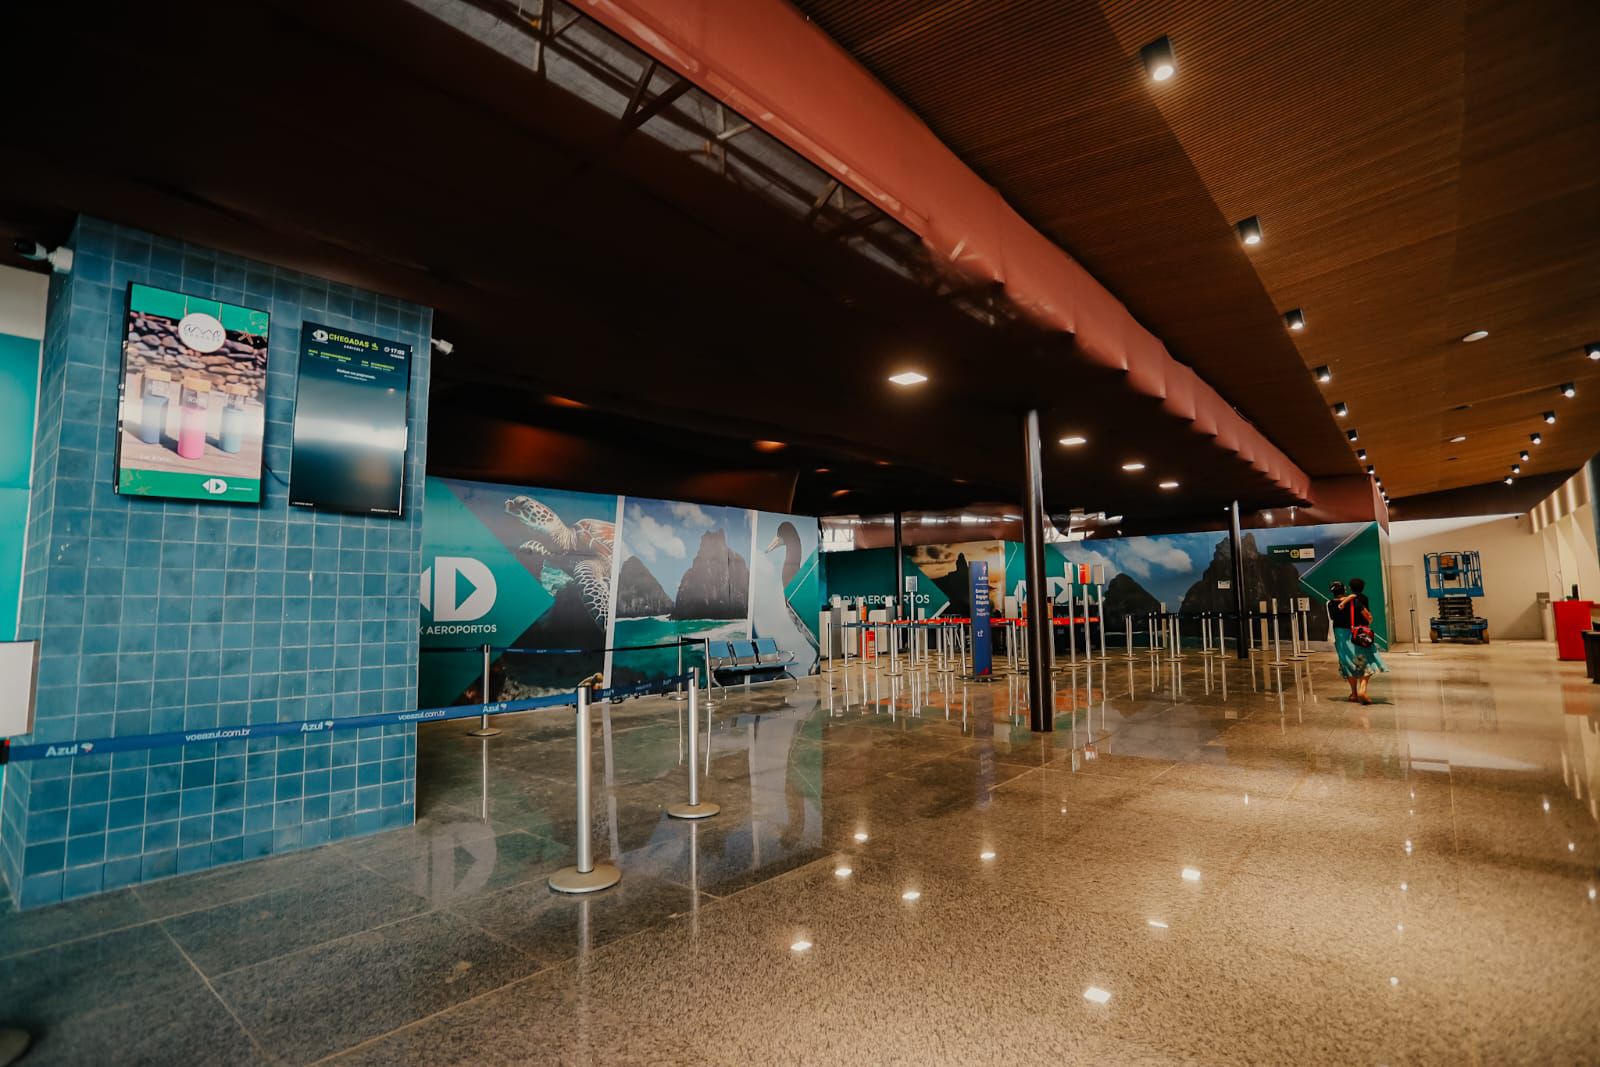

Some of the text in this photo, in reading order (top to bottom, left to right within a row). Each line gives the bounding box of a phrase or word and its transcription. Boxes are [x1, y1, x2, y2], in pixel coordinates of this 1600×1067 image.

[329, 333, 369, 348] CHEGADAS
[861, 594, 930, 605] AEROROS
[426, 624, 497, 635] AEROPORTOS
[45, 743, 78, 758] Azul
[300, 722, 323, 732] Azul
[482, 703, 500, 713] Azul
